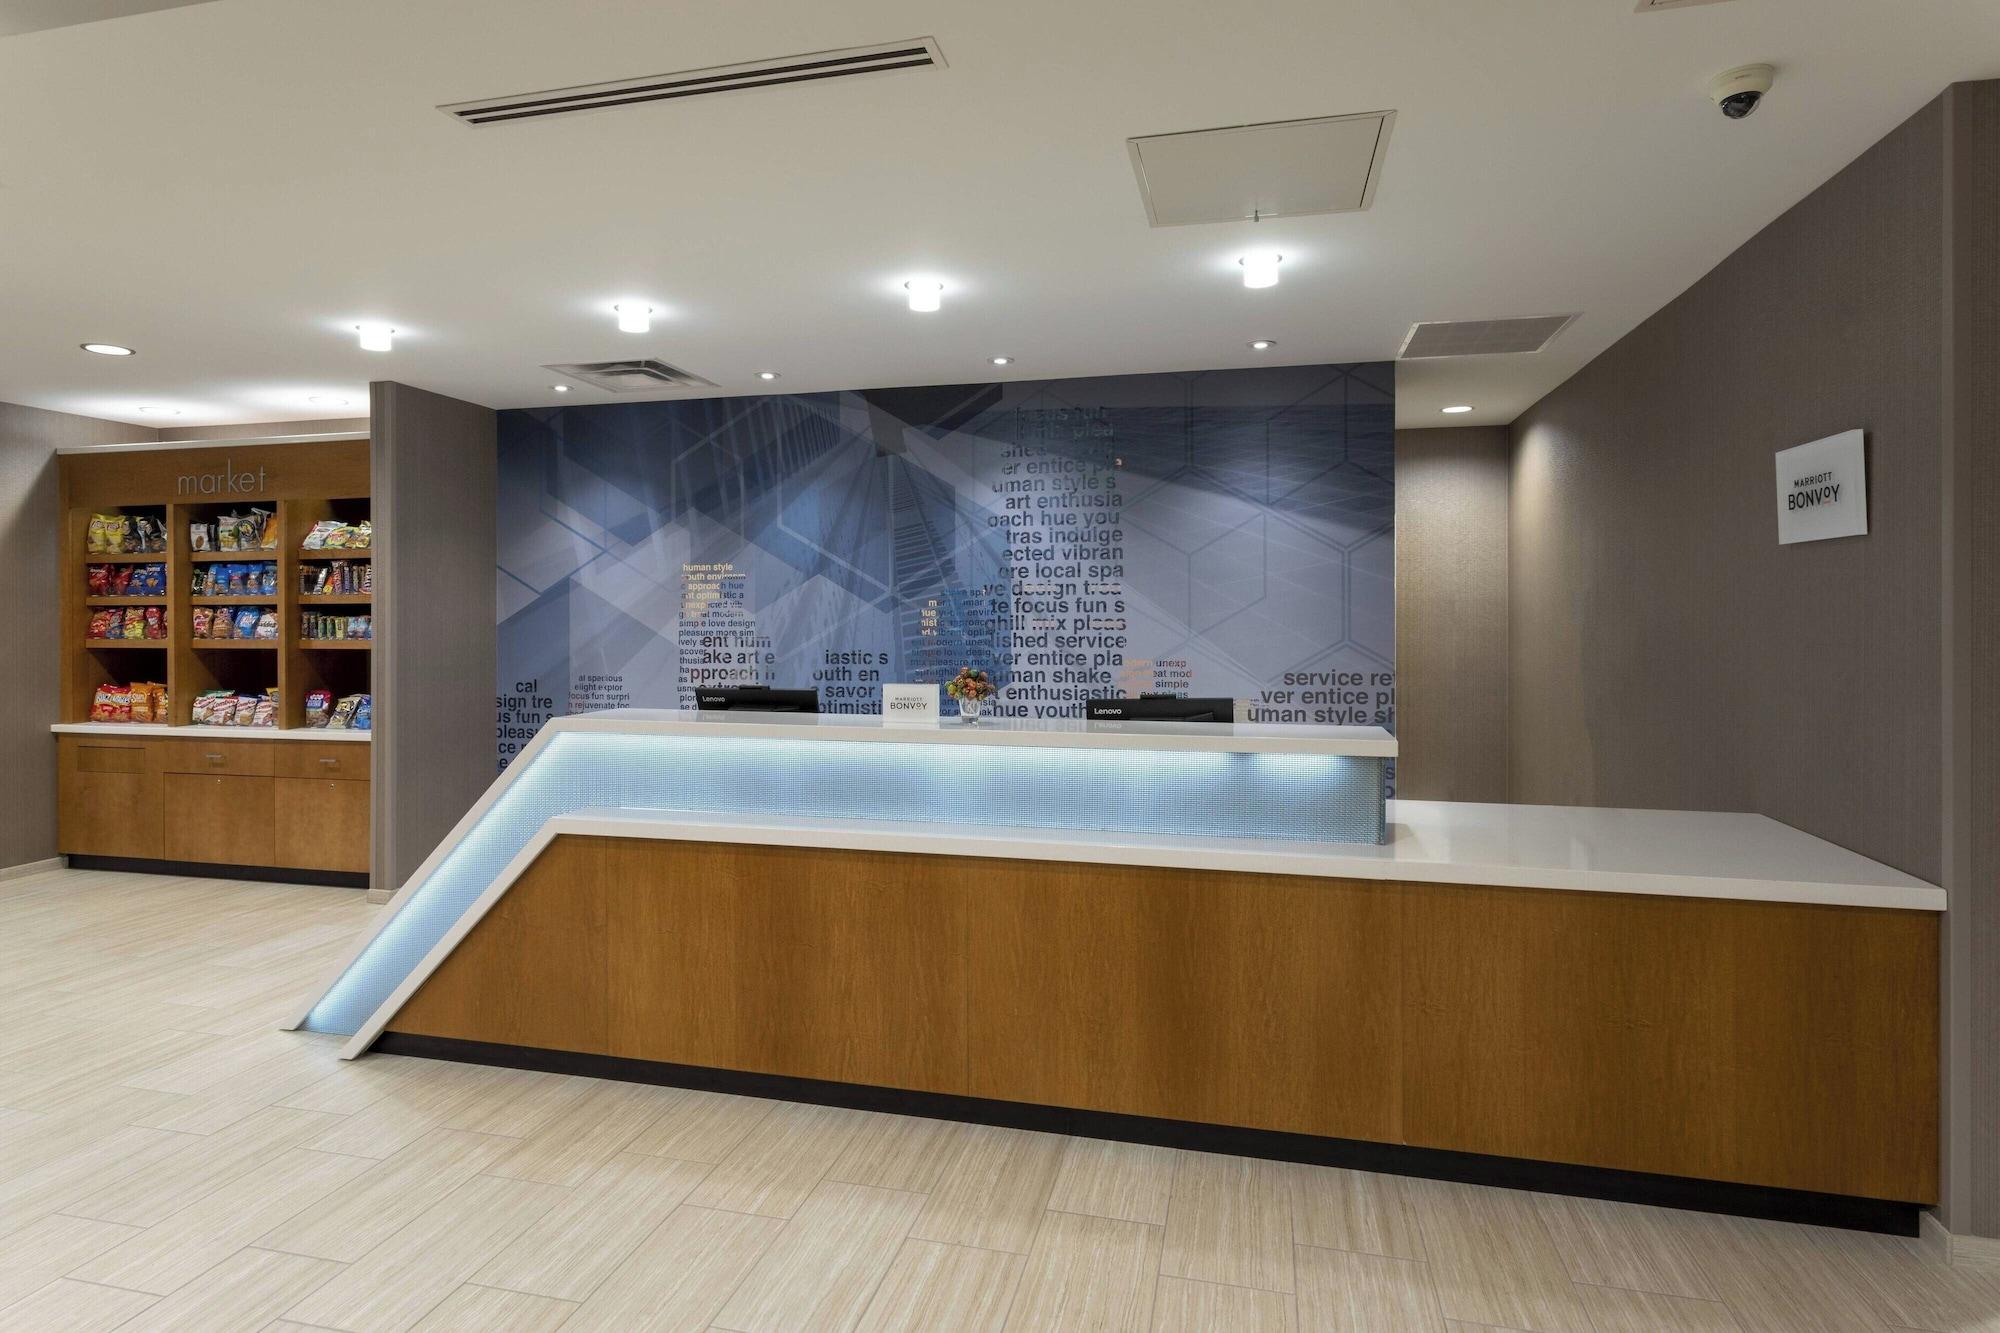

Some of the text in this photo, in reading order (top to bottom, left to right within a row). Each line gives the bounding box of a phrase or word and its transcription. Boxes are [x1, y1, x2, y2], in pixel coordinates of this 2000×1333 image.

[1026, 458, 1086, 474] entice
[178, 458, 266, 495] market
[1052, 475, 1099, 494] style
[1794, 472, 1832, 488] MARRIOTT
[1005, 491, 1122, 510] art enthusia
[1788, 484, 1840, 511] BONVOY
[988, 510, 1120, 529] oach hue you
[1006, 527, 1123, 546] tras indulge
[1003, 543, 1124, 561] ected vibran
[683, 563, 733, 573] human style
[1035, 562, 1081, 578] local
[1088, 564, 1124, 582] spa
[1014, 598, 1069, 613] focus
[1075, 598, 1107, 613] fun
[1114, 600, 1126, 613] s
[708, 619, 726, 627] love
[728, 619, 756, 629] design
[679, 629, 714, 638] pleasure
[716, 630, 737, 638] more
[1055, 633, 1127, 649] service
[703, 649, 775, 664] ake art e
[825, 650, 888, 665] iastic s
[1027, 650, 1087, 666] entice
[1094, 650, 1123, 670] pla
[690, 664, 759, 683] pproach
[858, 669, 879, 681] en
[1052, 667, 1112, 684] shake
[1284, 669, 1395, 686] service re
[515, 679, 537, 693] cal
[825, 683, 874, 698] savor
[1006, 684, 1127, 700] enthusiastic
[1155, 680, 1189, 690] simple
[532, 695, 553, 709] tre
[1261, 690, 1294, 704] ver
[1301, 687, 1369, 705] entice
[890, 702, 928, 710] BONVOY
[994, 704, 1028, 717] hue
[1094, 707, 1122, 715] Lenovo
[516, 709, 540, 723] fun
[1247, 708, 1306, 722] uman
[1315, 706, 1367, 725] style
